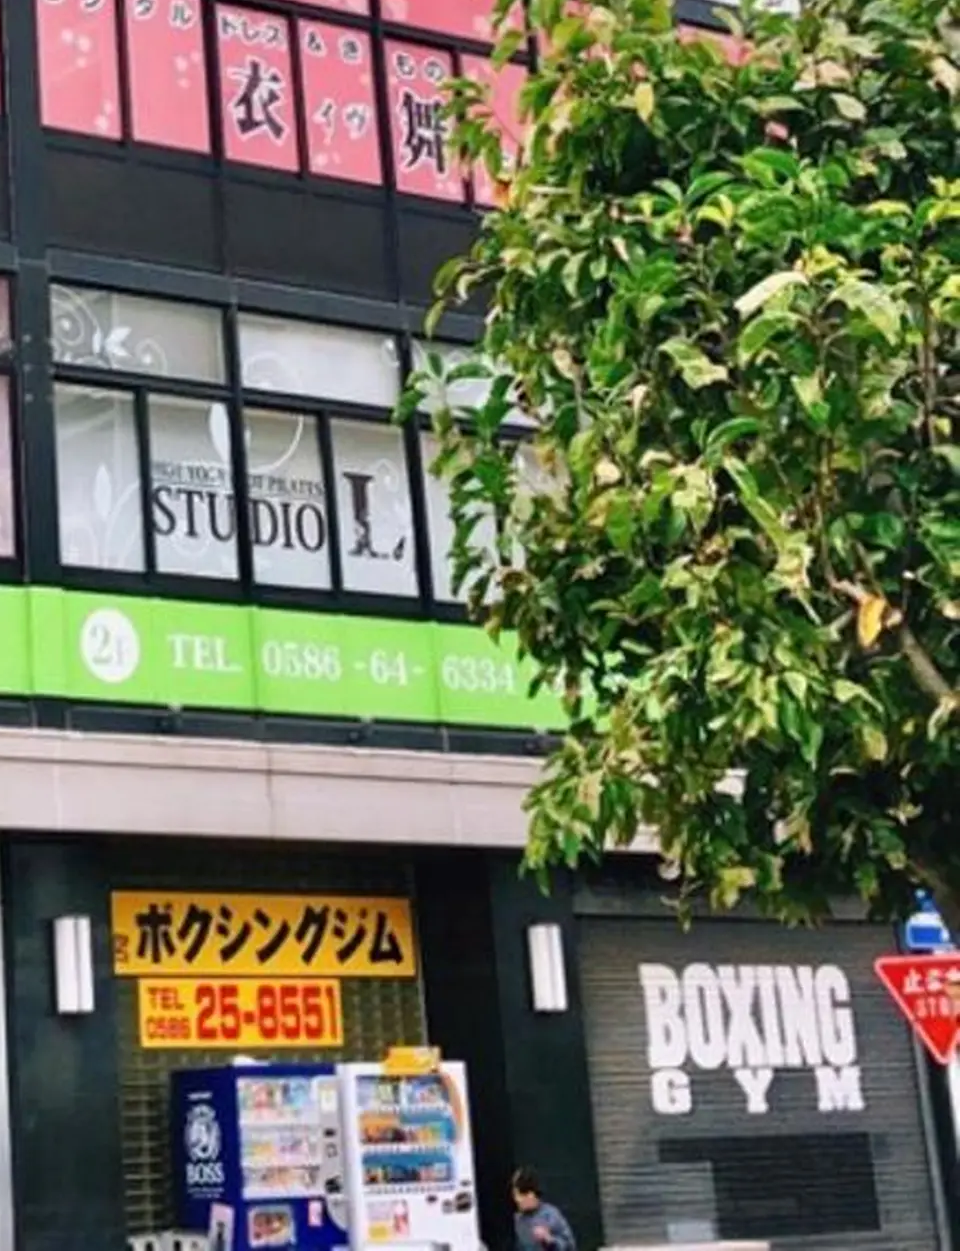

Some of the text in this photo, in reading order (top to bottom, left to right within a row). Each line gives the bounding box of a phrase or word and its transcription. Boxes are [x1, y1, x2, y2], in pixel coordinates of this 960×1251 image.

[152, 484, 326, 553] STUDIO
[135, 902, 403, 965] ボクシングジム
[147, 986, 185, 1011] TEL
[194, 983, 338, 1041] 25-8551
[639, 962, 858, 1069] BOXING
[650, 1067, 865, 1113] GYM
[186, 1161, 225, 1185] BOSS
